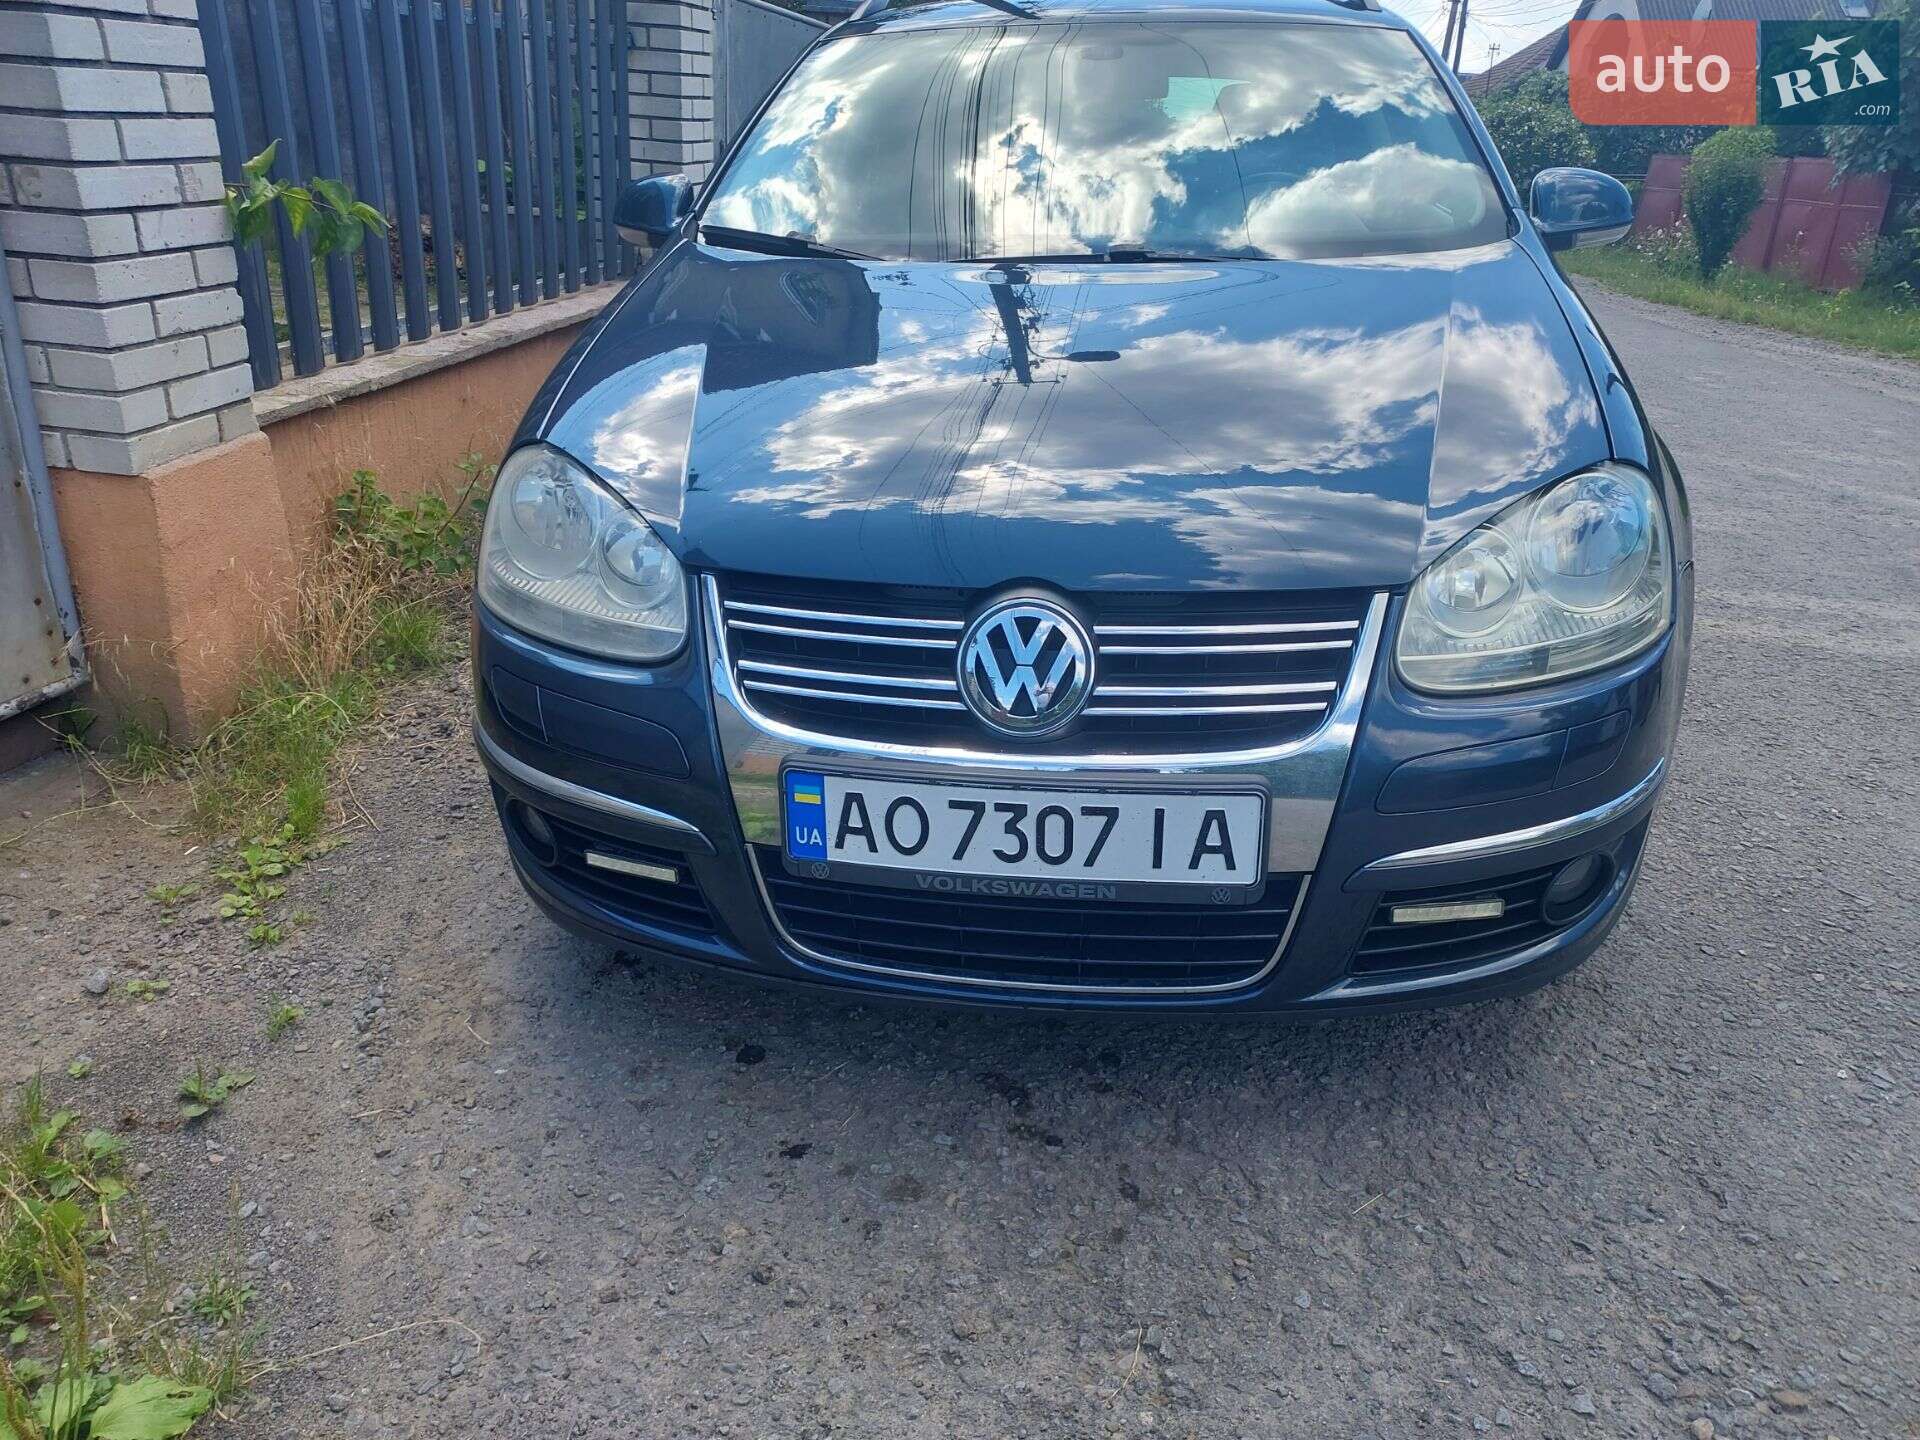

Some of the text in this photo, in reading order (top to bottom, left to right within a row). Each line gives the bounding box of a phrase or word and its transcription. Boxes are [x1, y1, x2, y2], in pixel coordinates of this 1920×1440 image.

[795, 826, 823, 846] UA
[834, 791, 1237, 870] AO 7307 IA
[915, 874, 1117, 900] VOLKSWAGEN
